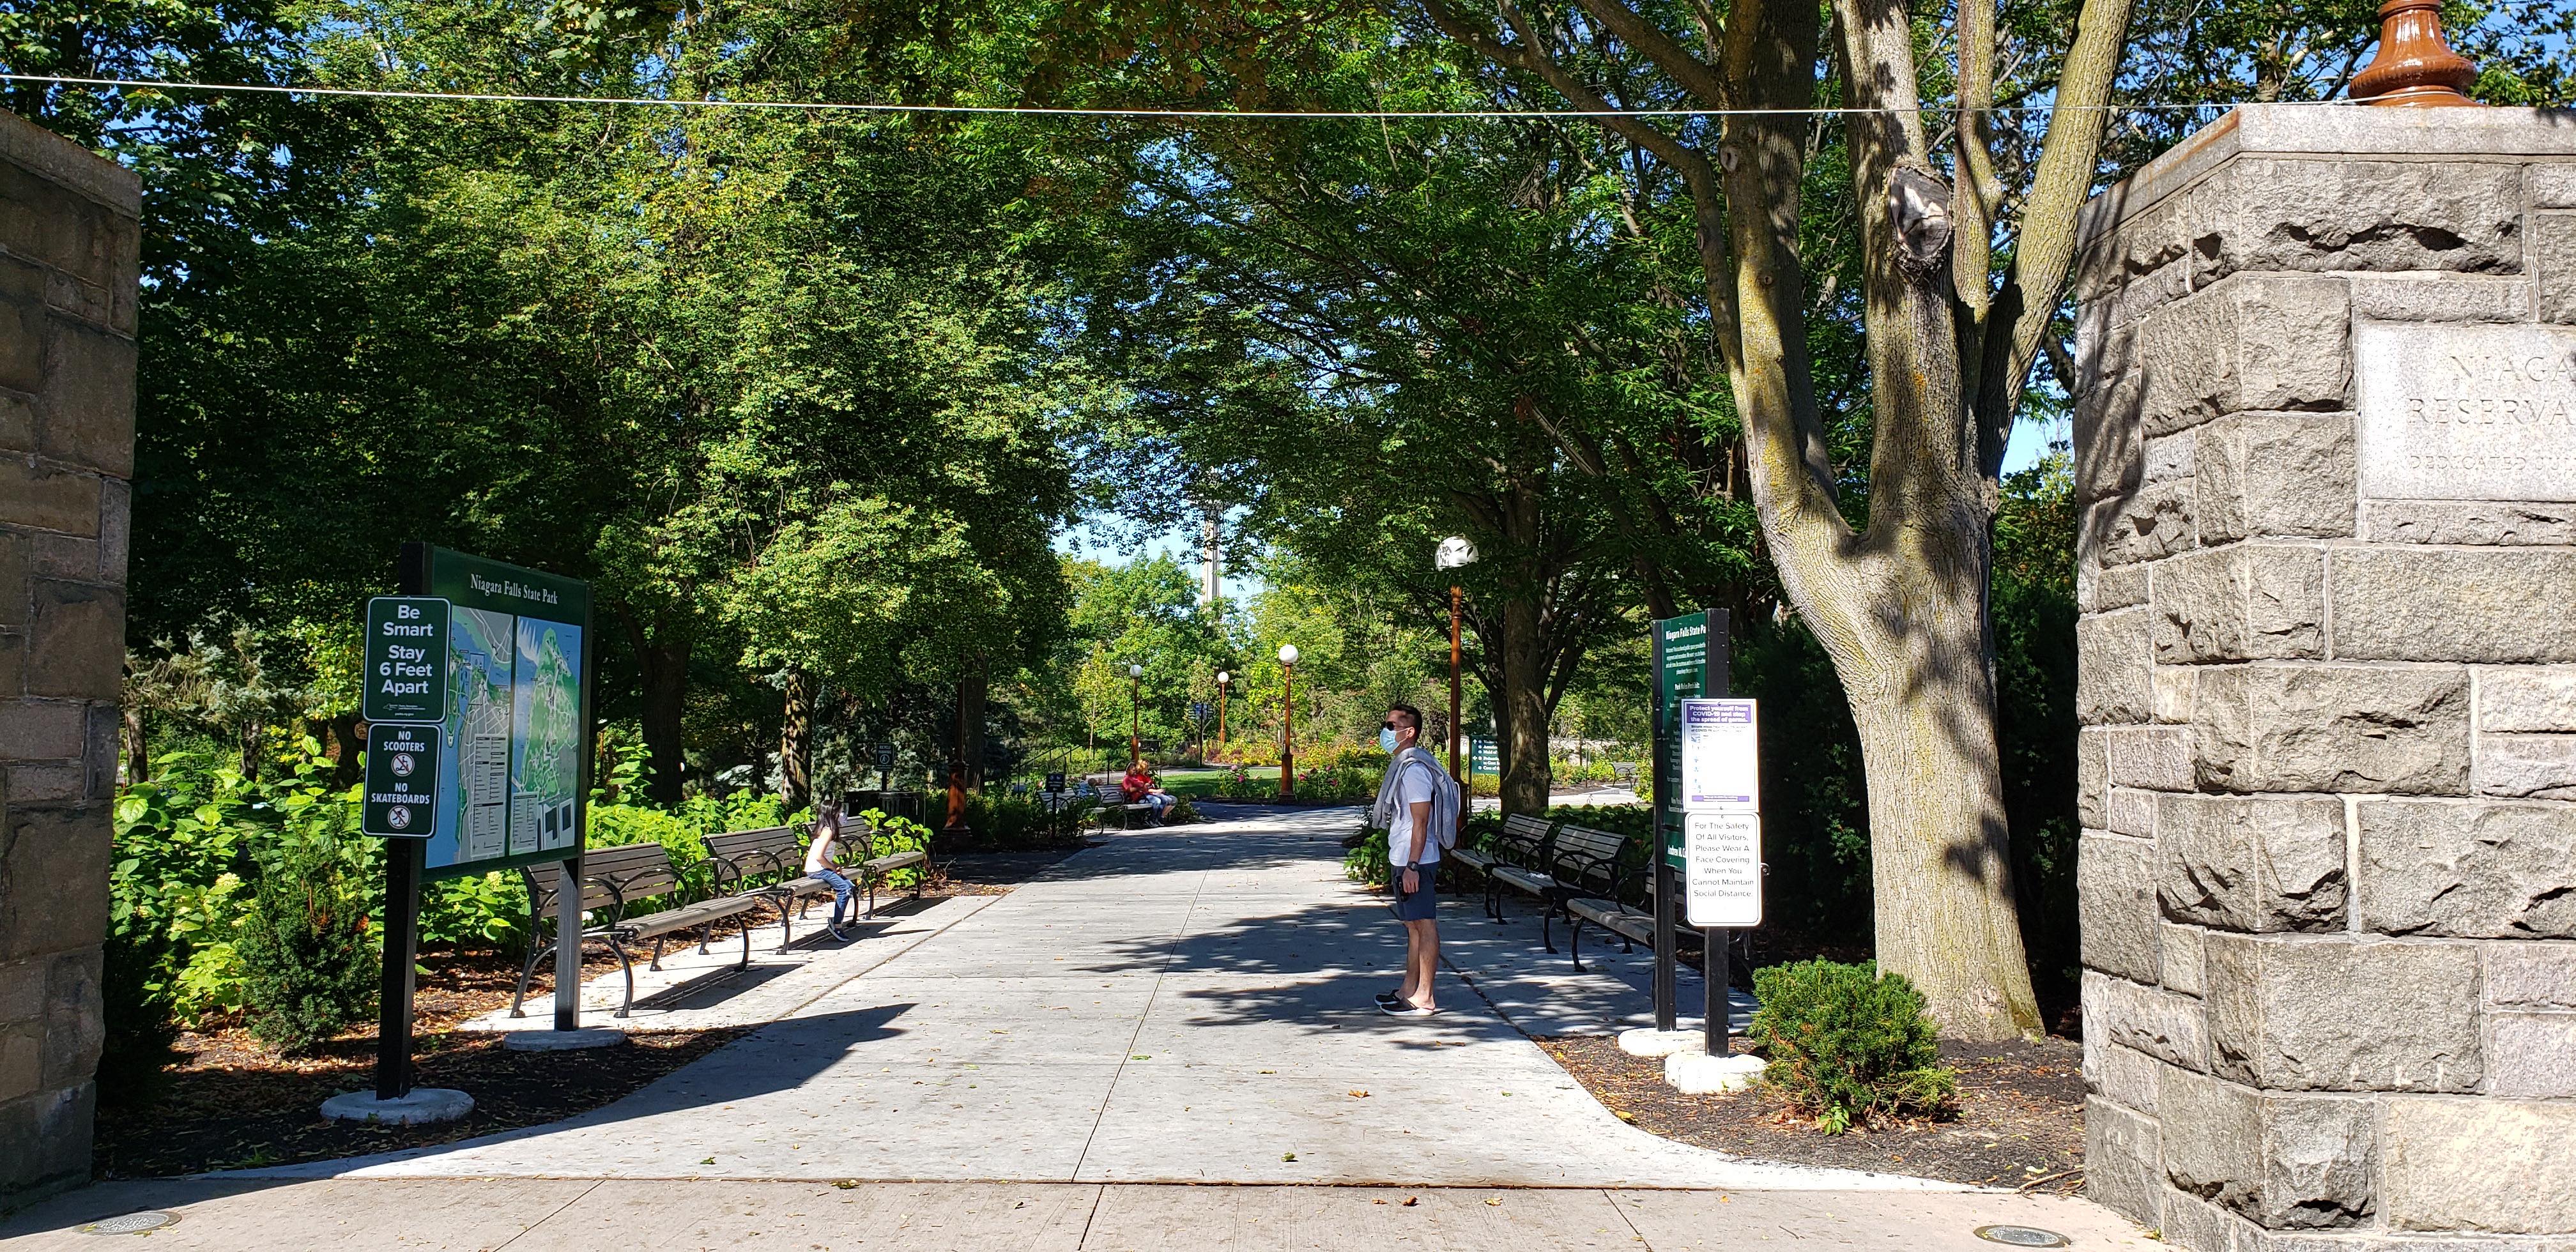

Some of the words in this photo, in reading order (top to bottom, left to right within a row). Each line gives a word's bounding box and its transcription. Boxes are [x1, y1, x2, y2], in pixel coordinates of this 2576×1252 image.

[2409, 399, 2575, 425] RESERVA
[2410, 455, 2526, 470] DEDICATED
[2535, 456, 2576, 471] JUL
[470, 573, 502, 597] Niagara
[503, 580, 521, 598] Falls
[523, 584, 540, 601] State
[542, 588, 558, 605] Park
[397, 604, 420, 620] Be
[383, 622, 434, 637] Smart
[1666, 630, 1680, 642] Niagara
[1680, 626, 1689, 639] Falls
[1689, 625, 1700, 637] State
[388, 645, 425, 663] Stay
[379, 662, 391, 676] 6
[395, 662, 433, 677] Feet
[381, 679, 429, 697] Apart
[398, 731, 411, 740] NO
[383, 741, 425, 752] SCOOTERS
[395, 782, 408, 793] NO
[371, 793, 430, 805] SKATEBOARDS
[1726, 822, 1749, 830] Safety
[1715, 856, 1750, 865] Covering
